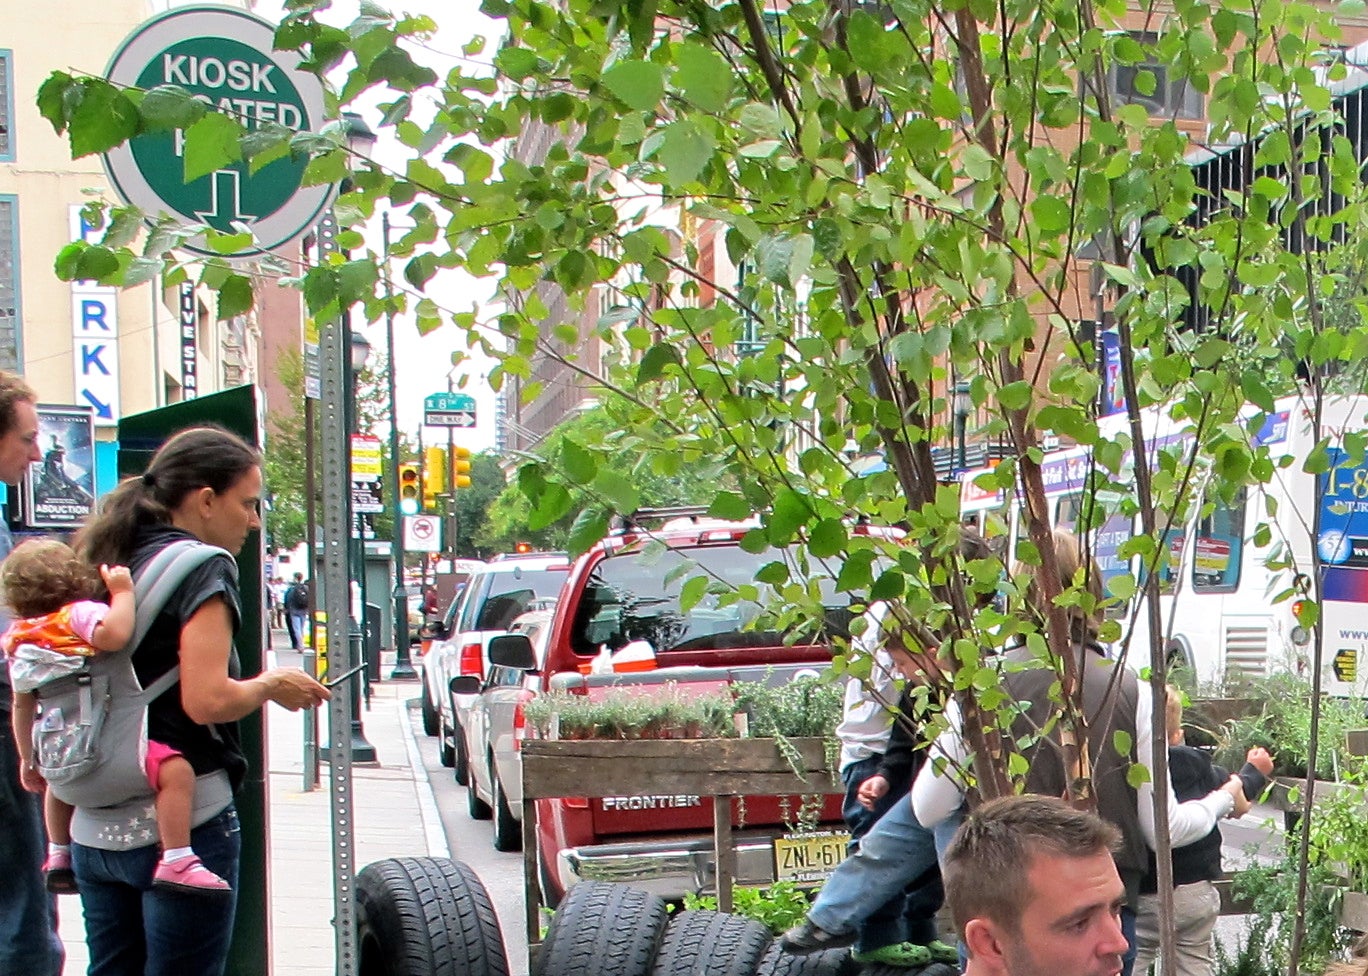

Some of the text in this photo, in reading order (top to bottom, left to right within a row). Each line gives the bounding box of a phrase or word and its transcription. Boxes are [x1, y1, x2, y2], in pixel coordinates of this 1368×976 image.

[164, 53, 277, 94] KIOSK
[79, 207, 110, 375] PRK
[182, 282, 194, 338] FIVE
[36, 504, 90, 514] ABDUCTION
[602, 794, 701, 811] FRONTIER
